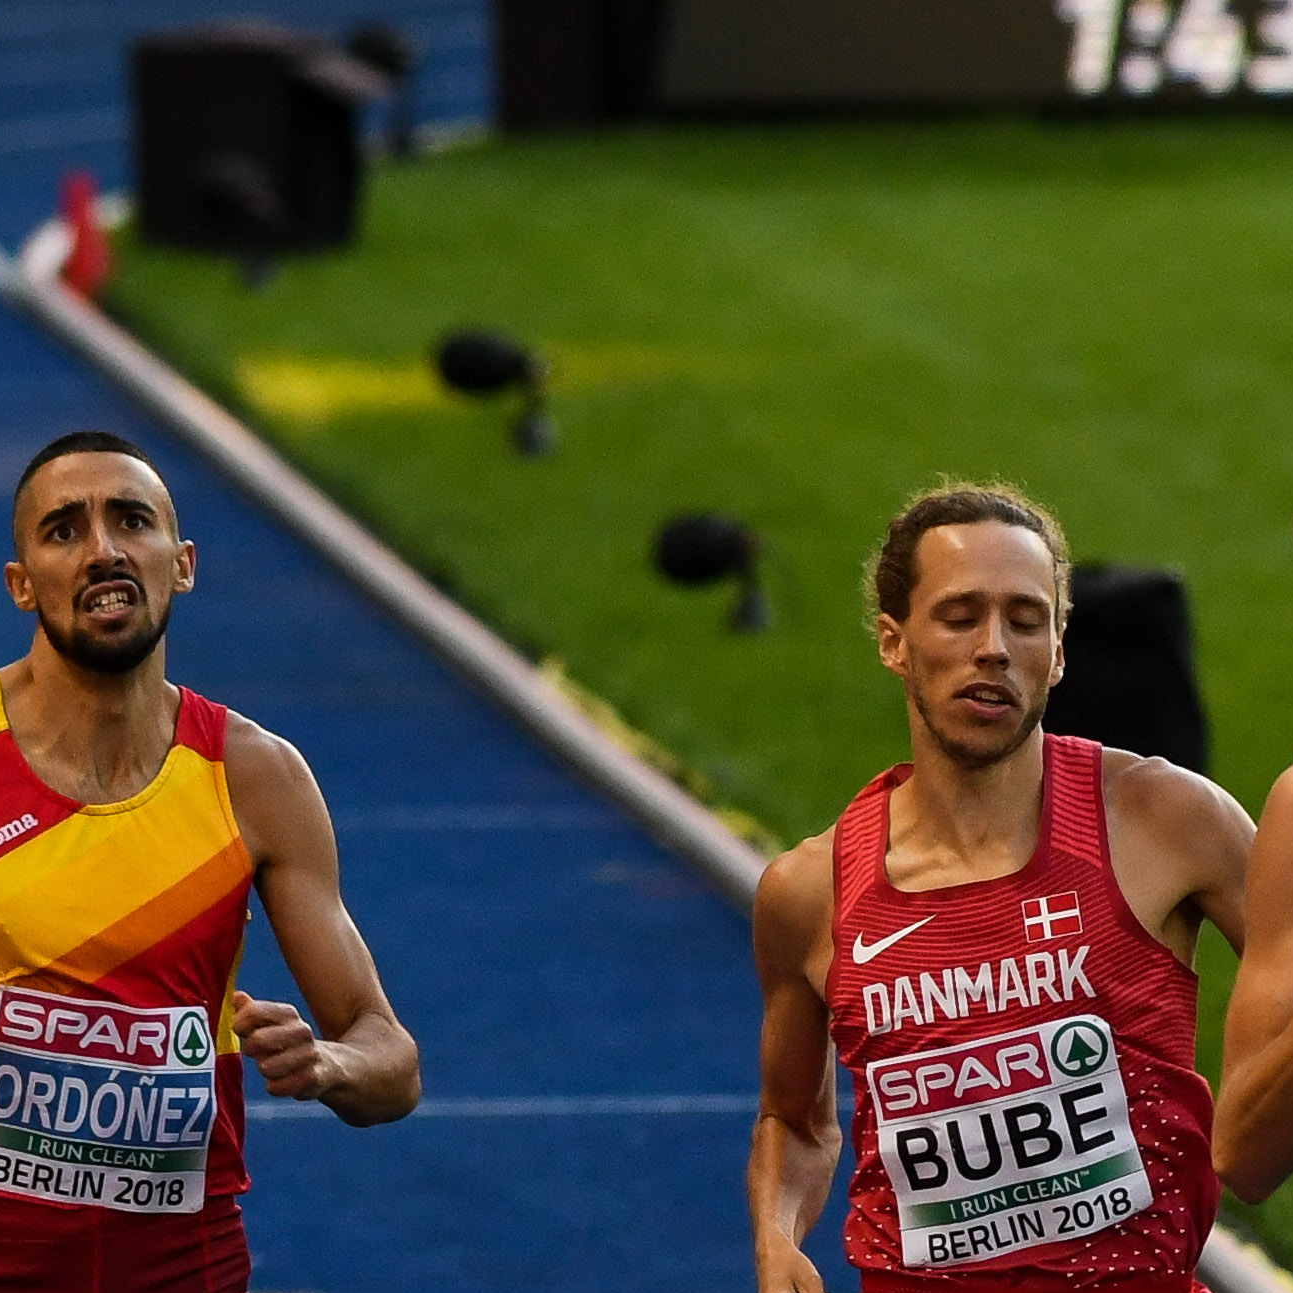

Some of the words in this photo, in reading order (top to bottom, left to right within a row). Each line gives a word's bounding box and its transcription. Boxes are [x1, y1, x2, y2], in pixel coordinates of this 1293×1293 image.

[862, 944, 1097, 1037] DANMARK
[1, 1000, 168, 1059] SPAR
[878, 1041, 1045, 1111] SPAR
[38, 1138, 84, 1161] RUN
[895, 1081, 1116, 1192] BUBE
[113, 1176, 185, 1207] 2018
[961, 1190, 1009, 1218] RUN
[926, 1208, 1046, 1264] BERLIN
[1051, 1187, 1133, 1234] 2018
